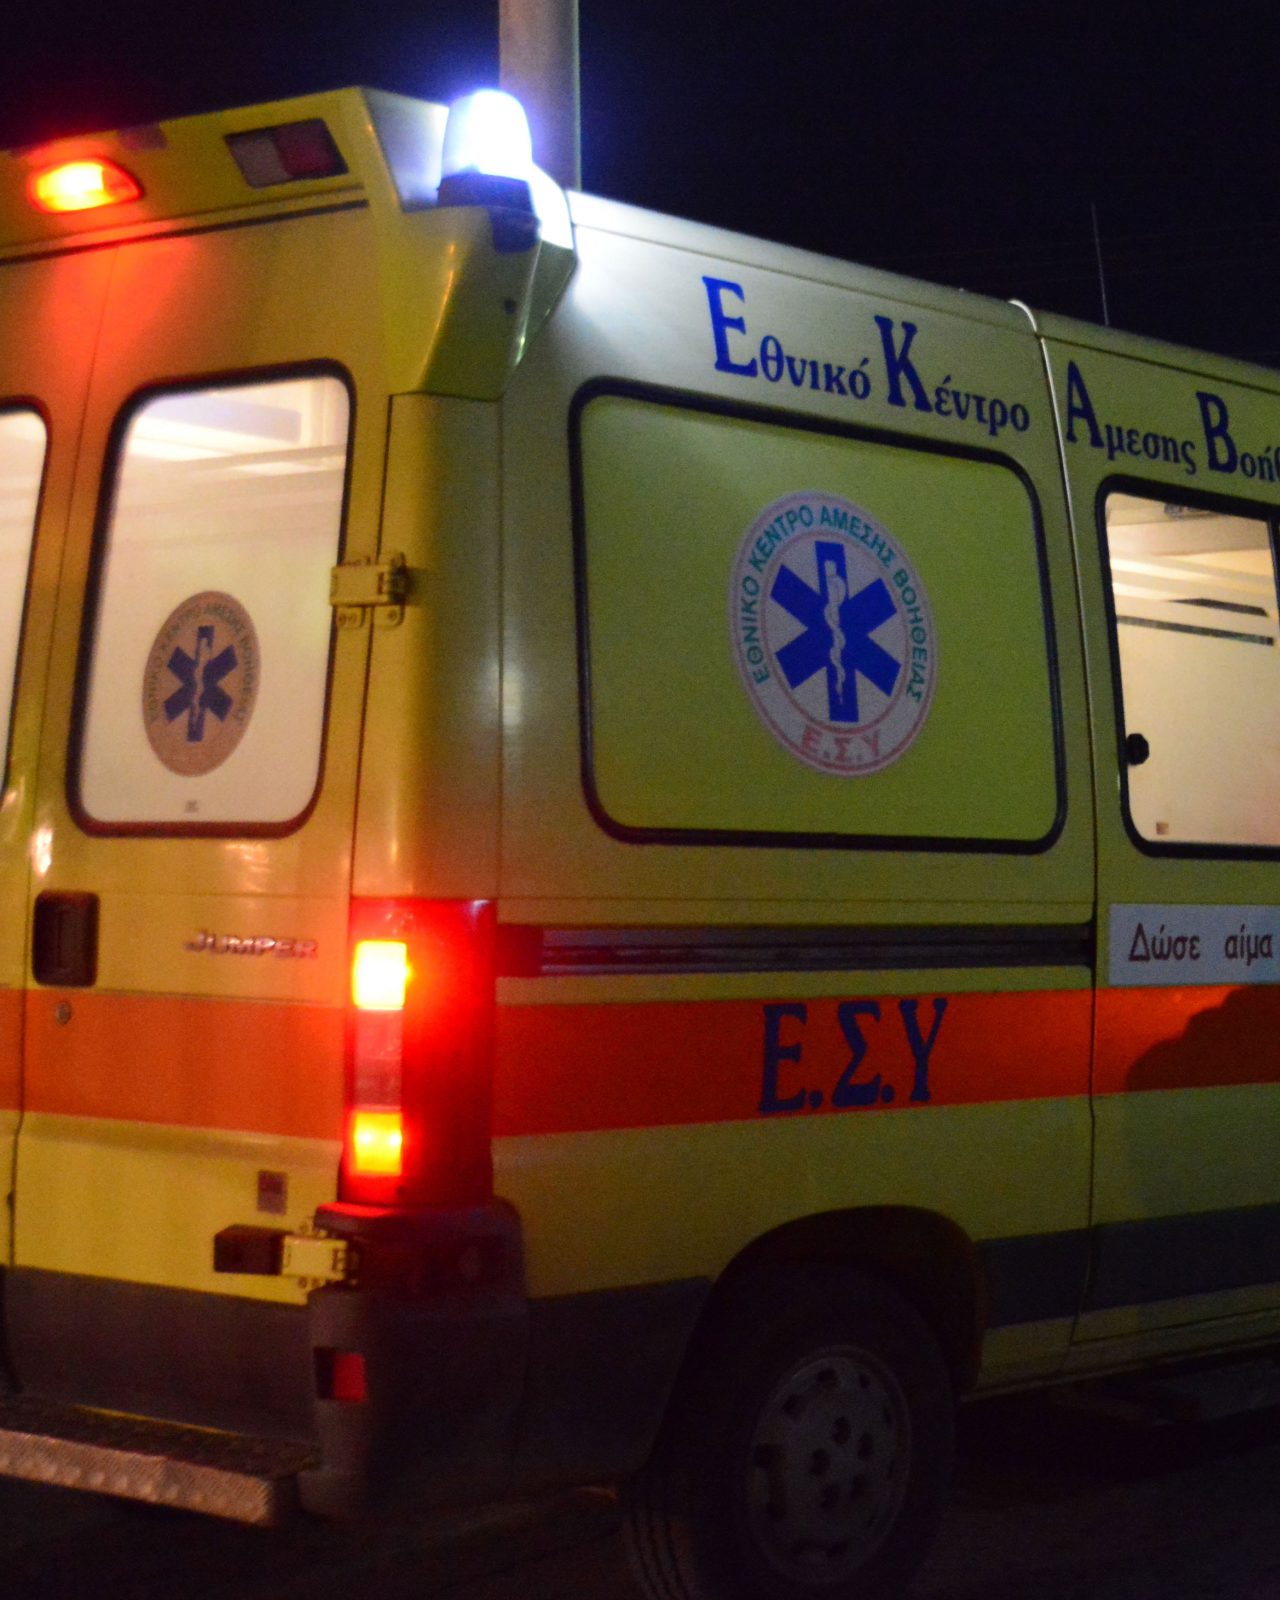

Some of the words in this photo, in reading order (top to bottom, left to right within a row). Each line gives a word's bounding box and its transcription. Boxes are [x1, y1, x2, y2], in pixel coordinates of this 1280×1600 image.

[702, 275, 871, 400] Εθνικό
[874, 315, 1030, 436] Κέντρο
[1066, 361, 1196, 474] Αμεσης
[748, 505, 813, 573] ΚΕΝΤΡΟ
[820, 505, 896, 568] ΑΜΕΣΗΣ
[742, 576, 771, 685] ΕΘΝΙΚΟ
[894, 569, 928, 702] ΒΟΗΘΕΙΑΣ
[1128, 922, 1200, 962] Δώσε
[1224, 928, 1273, 965] αίμα
